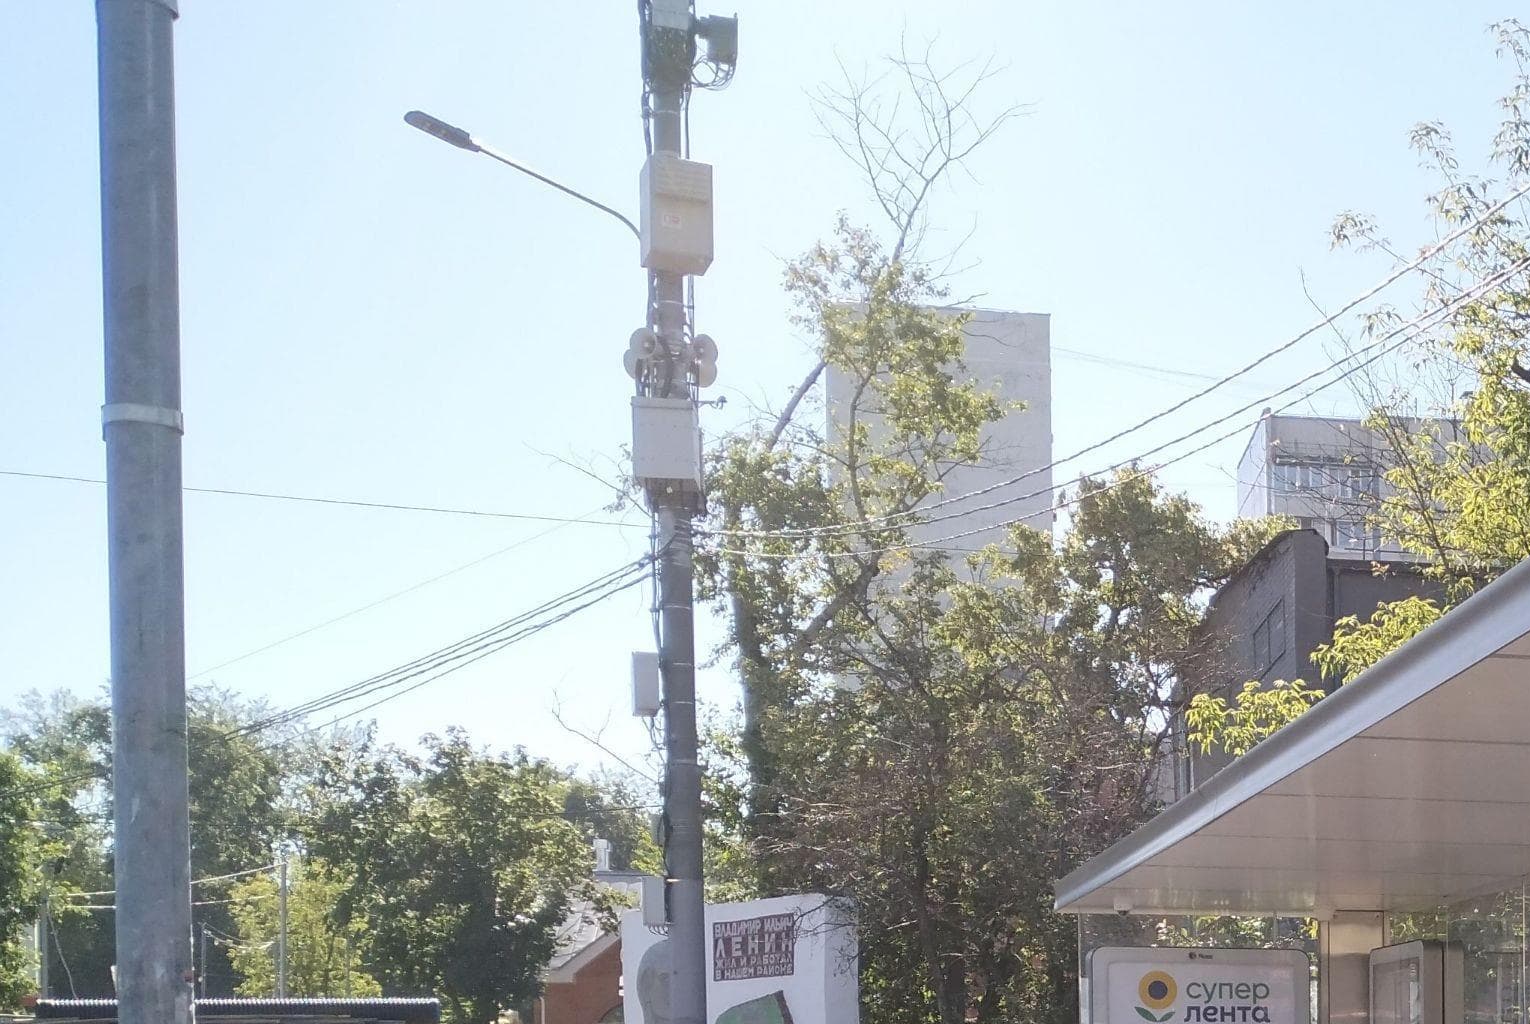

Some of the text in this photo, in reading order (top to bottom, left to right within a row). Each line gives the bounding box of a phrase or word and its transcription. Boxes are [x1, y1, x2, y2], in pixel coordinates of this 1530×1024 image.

[714, 916, 793, 938] ВЛАДИМИР ИЛЬИЧ
[716, 932, 792, 958] ЛЕНИН
[716, 958, 736, 969] ЖИЛ
[751, 953, 792, 965] РАБОТАЛ
[725, 966, 755, 979] НАШЕМ
[1186, 982, 1269, 1004] супер
[1184, 1006, 1270, 1023] лента
